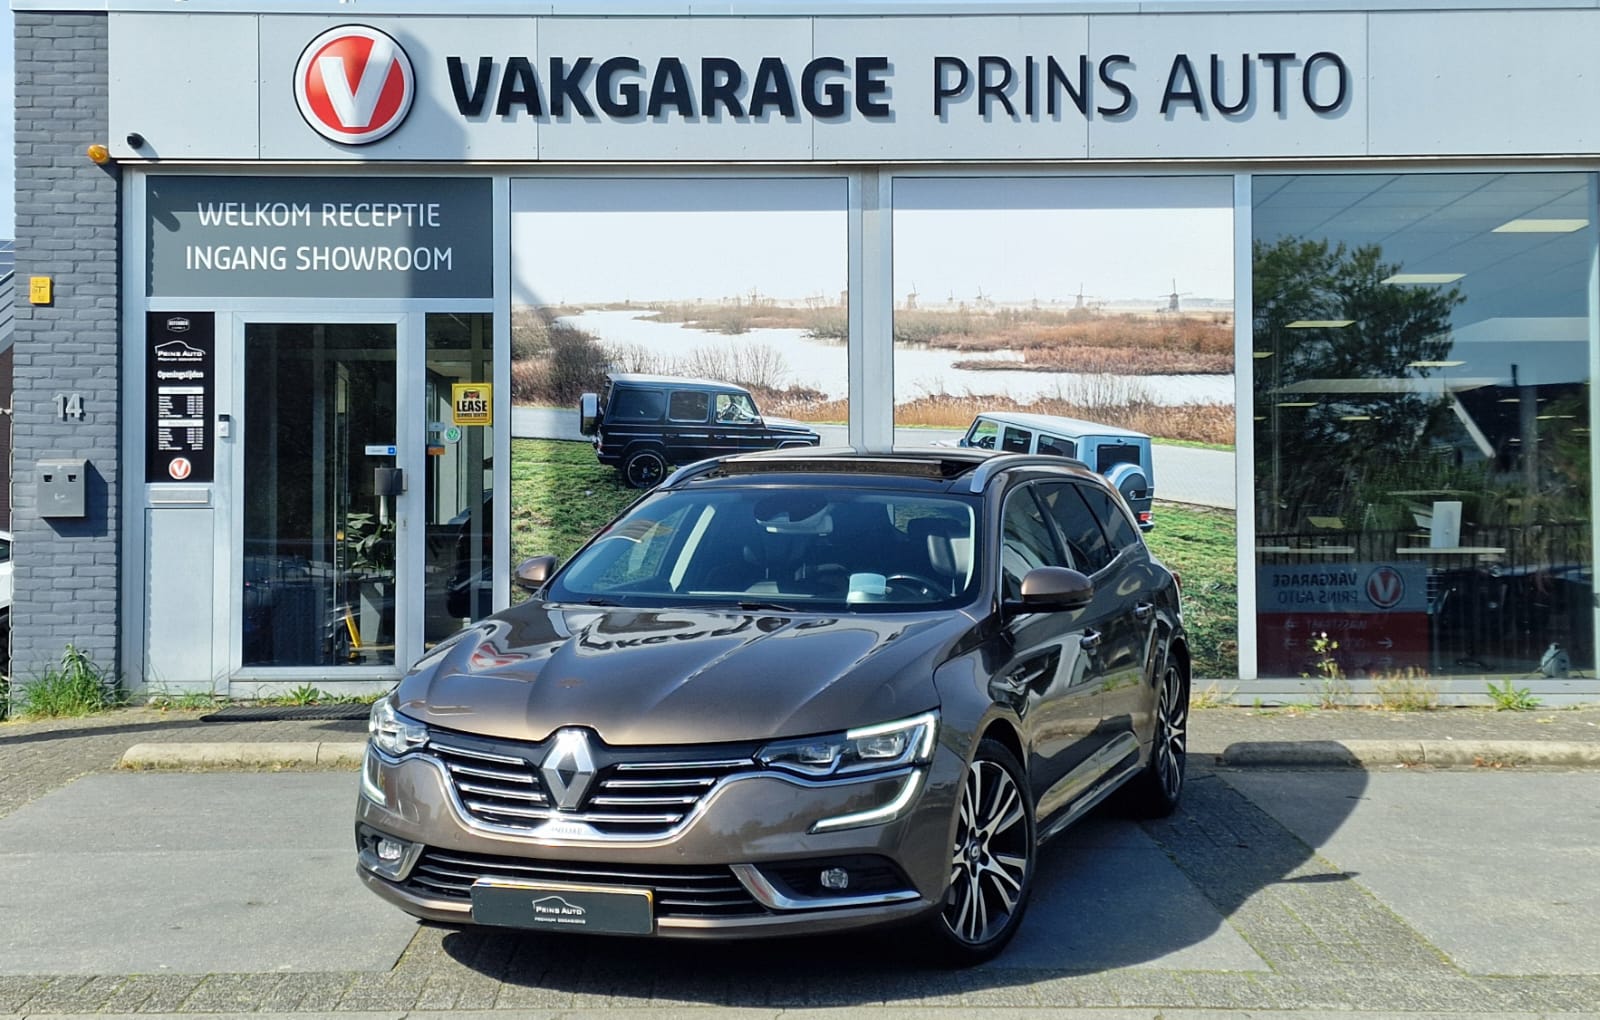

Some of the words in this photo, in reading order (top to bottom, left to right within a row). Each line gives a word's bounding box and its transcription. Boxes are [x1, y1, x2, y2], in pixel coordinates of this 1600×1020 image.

[446, 56, 890, 118] VAKGARAGE
[933, 54, 1132, 116] PRINS
[1160, 51, 1348, 115] AUTO
[197, 202, 311, 227] WELKOM
[322, 203, 441, 227] RECEPTIE
[186, 246, 287, 271] INGANG
[296, 247, 452, 271] SHOWROOM
[52, 393, 83, 419] 14
[456, 400, 487, 412] LEASE
[535, 905, 560, 914] PRINS
[561, 907, 583, 916] AUTO
